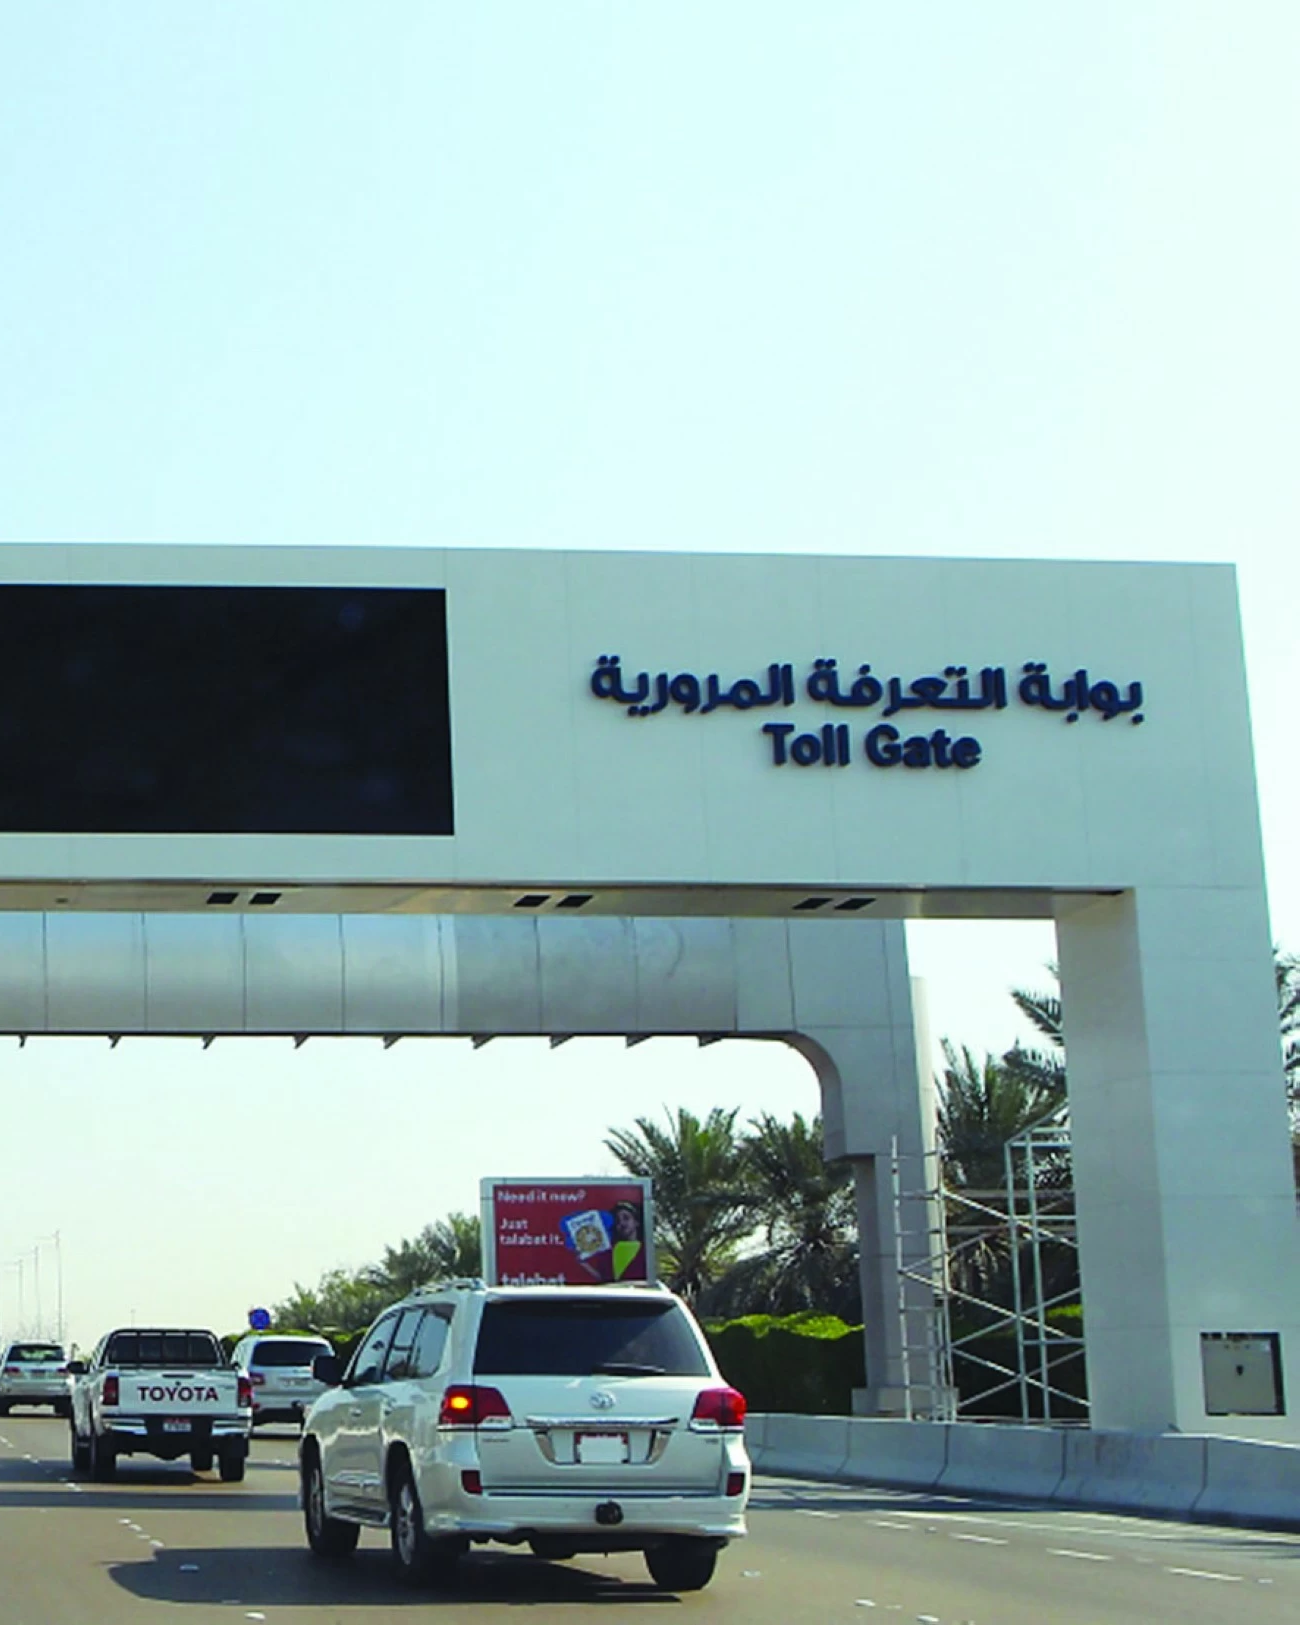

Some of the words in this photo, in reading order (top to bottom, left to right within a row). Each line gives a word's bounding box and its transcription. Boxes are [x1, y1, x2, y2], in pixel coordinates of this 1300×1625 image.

[589, 654, 795, 717] المرورية
[806, 657, 1008, 718] التعرفة
[1017, 660, 1146, 725] بوابة
[762, 722, 851, 768] Toll
[863, 722, 983, 770] Gate
[497, 1189, 535, 1203] Need
[500, 1217, 529, 1230] Just
[137, 1385, 219, 1402] TOYOTA
